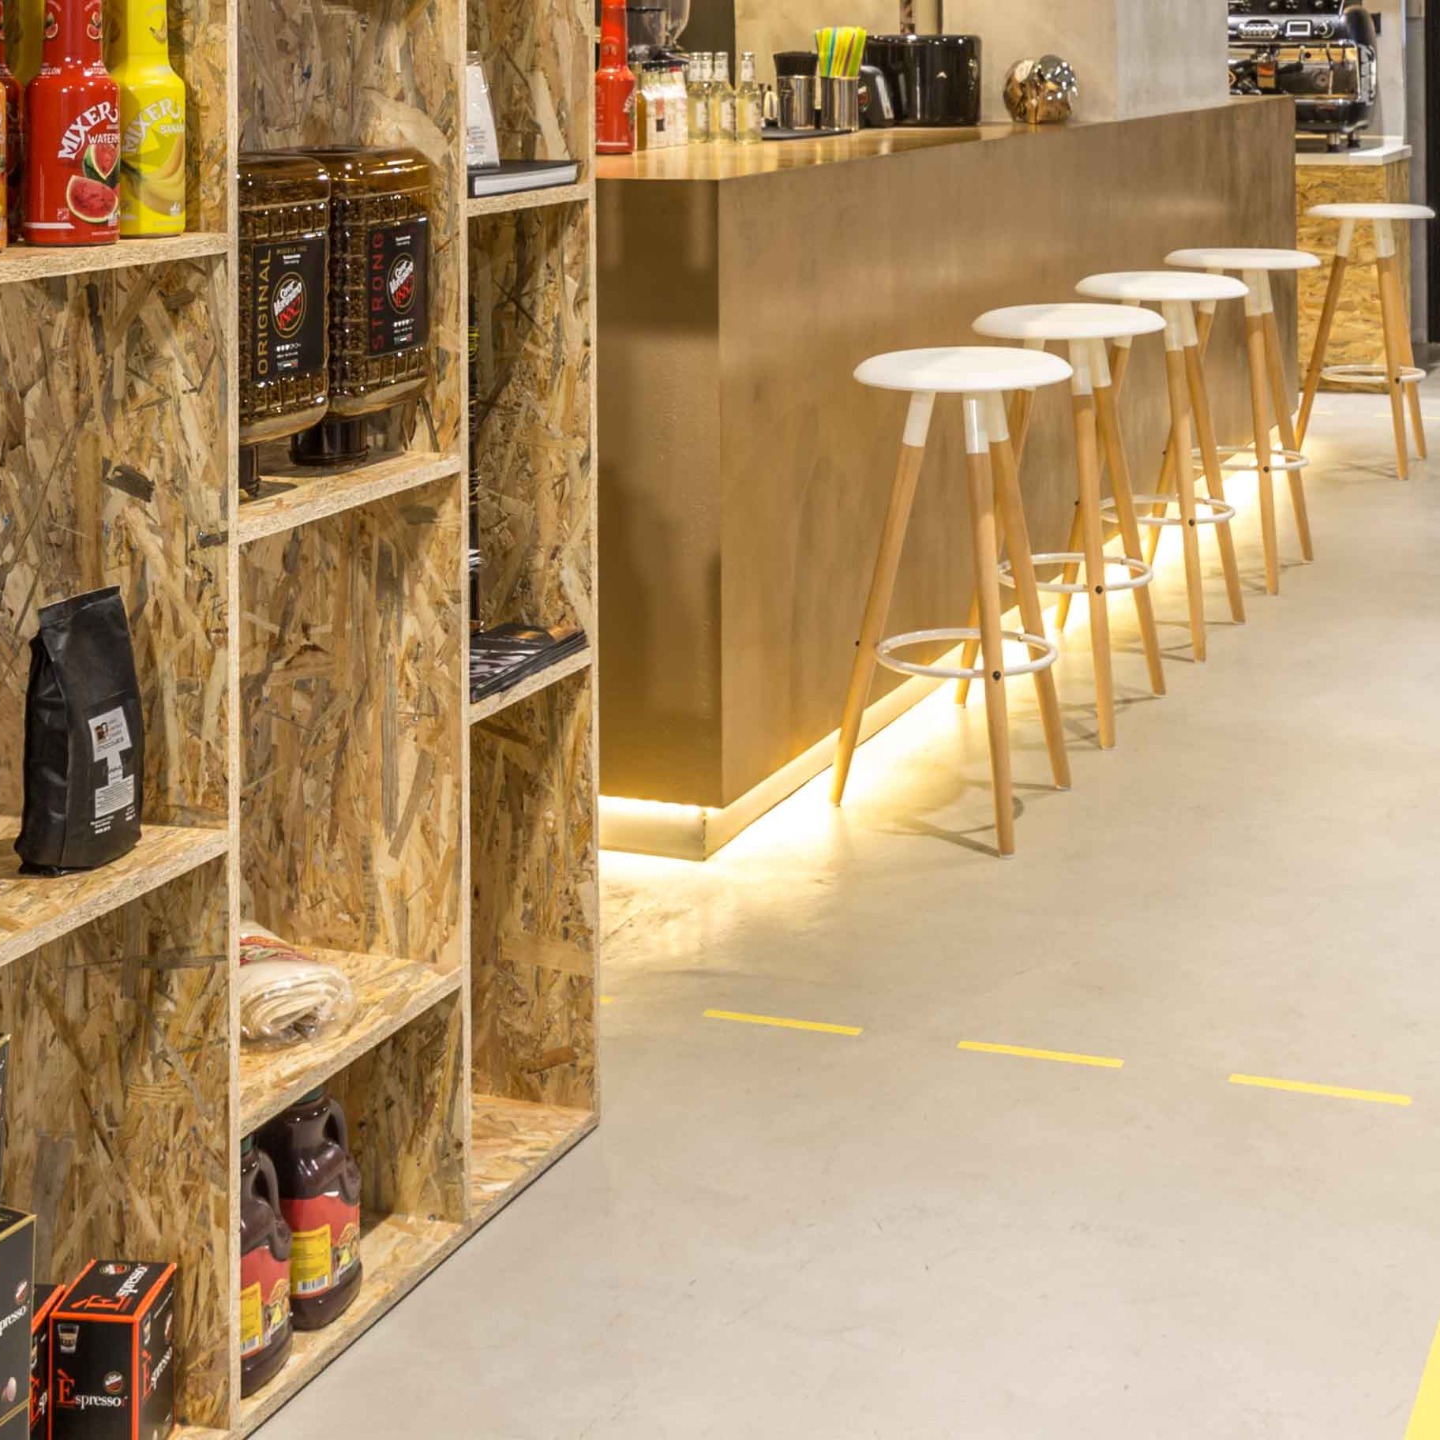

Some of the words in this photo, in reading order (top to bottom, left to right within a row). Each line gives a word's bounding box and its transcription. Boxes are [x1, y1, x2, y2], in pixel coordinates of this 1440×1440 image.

[58, 100, 119, 160] MIXER
[122, 97, 182, 154] MIXER
[257, 249, 272, 375] ORIGINAL
[371, 233, 384, 350] STRONG
[57, 1368, 123, 1410] Èspresso
